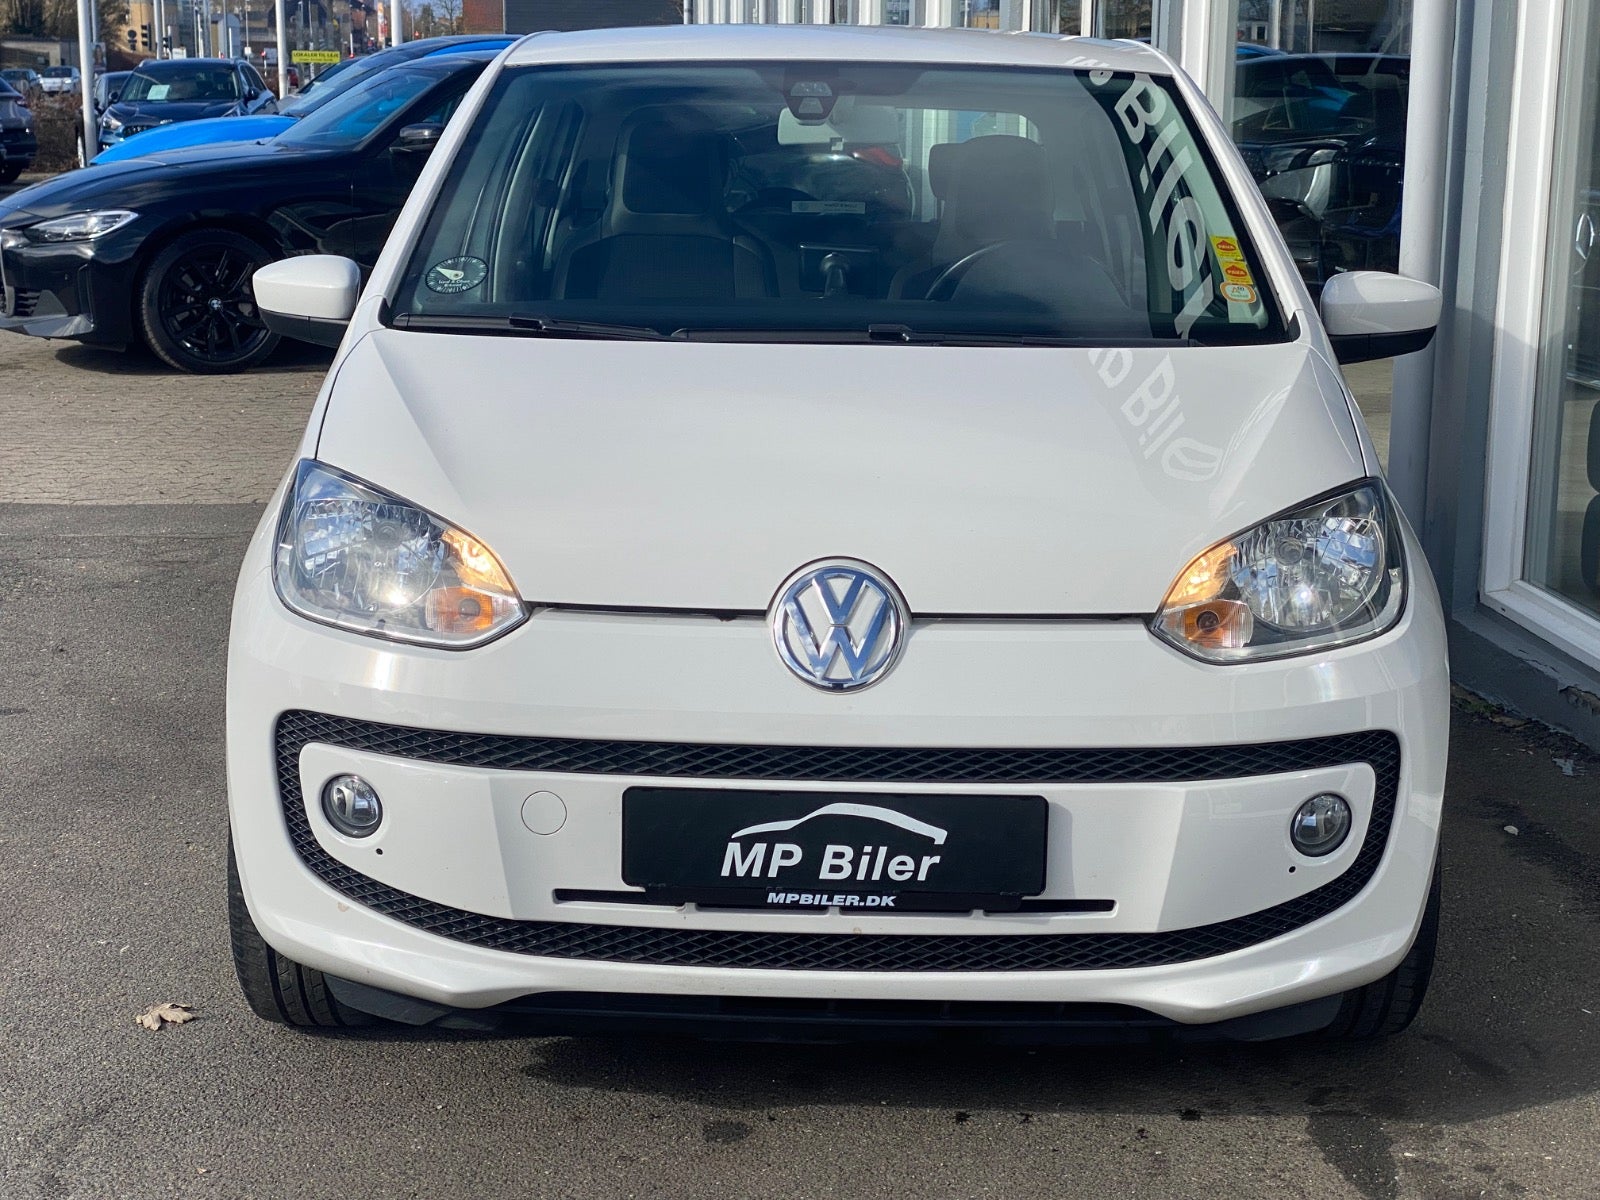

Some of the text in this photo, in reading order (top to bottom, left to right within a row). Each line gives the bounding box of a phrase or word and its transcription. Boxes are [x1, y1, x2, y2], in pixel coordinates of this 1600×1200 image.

[721, 842, 941, 881] MP Biler
[766, 892, 896, 907] MPBILER.DK
